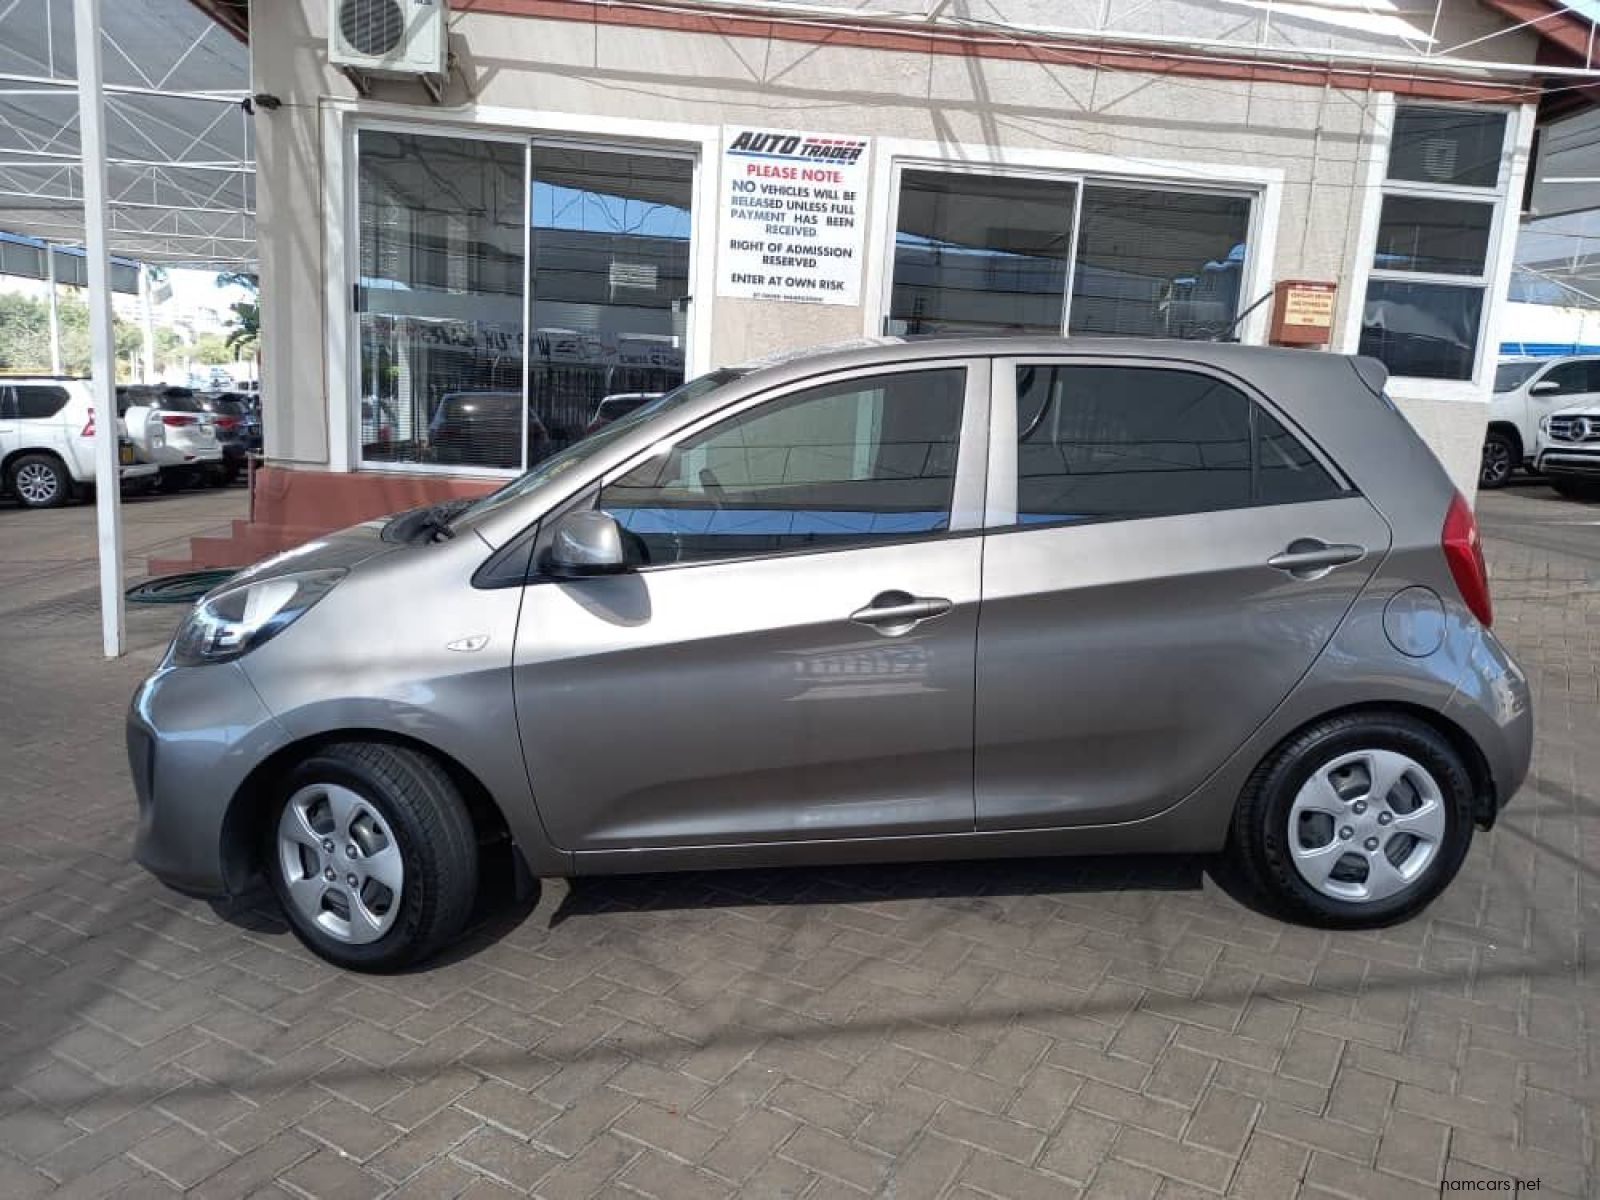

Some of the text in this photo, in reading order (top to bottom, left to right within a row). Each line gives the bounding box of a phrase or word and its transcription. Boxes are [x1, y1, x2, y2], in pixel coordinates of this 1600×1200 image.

[730, 131, 864, 161] AUTO TRADER
[747, 164, 798, 180] PLEASE
[732, 179, 857, 201] NO VEHICLES WILL BE
[731, 196, 856, 215] RELEASED UNLESS FULL
[731, 208, 854, 228] PAYMENT HAS BEEN
[765, 224, 817, 238] RECEIVED
[729, 239, 852, 258] RIGHT OF ADMISSION
[762, 255, 817, 268] RESERVED
[730, 272, 846, 292] ENTER AT OWN RISK
